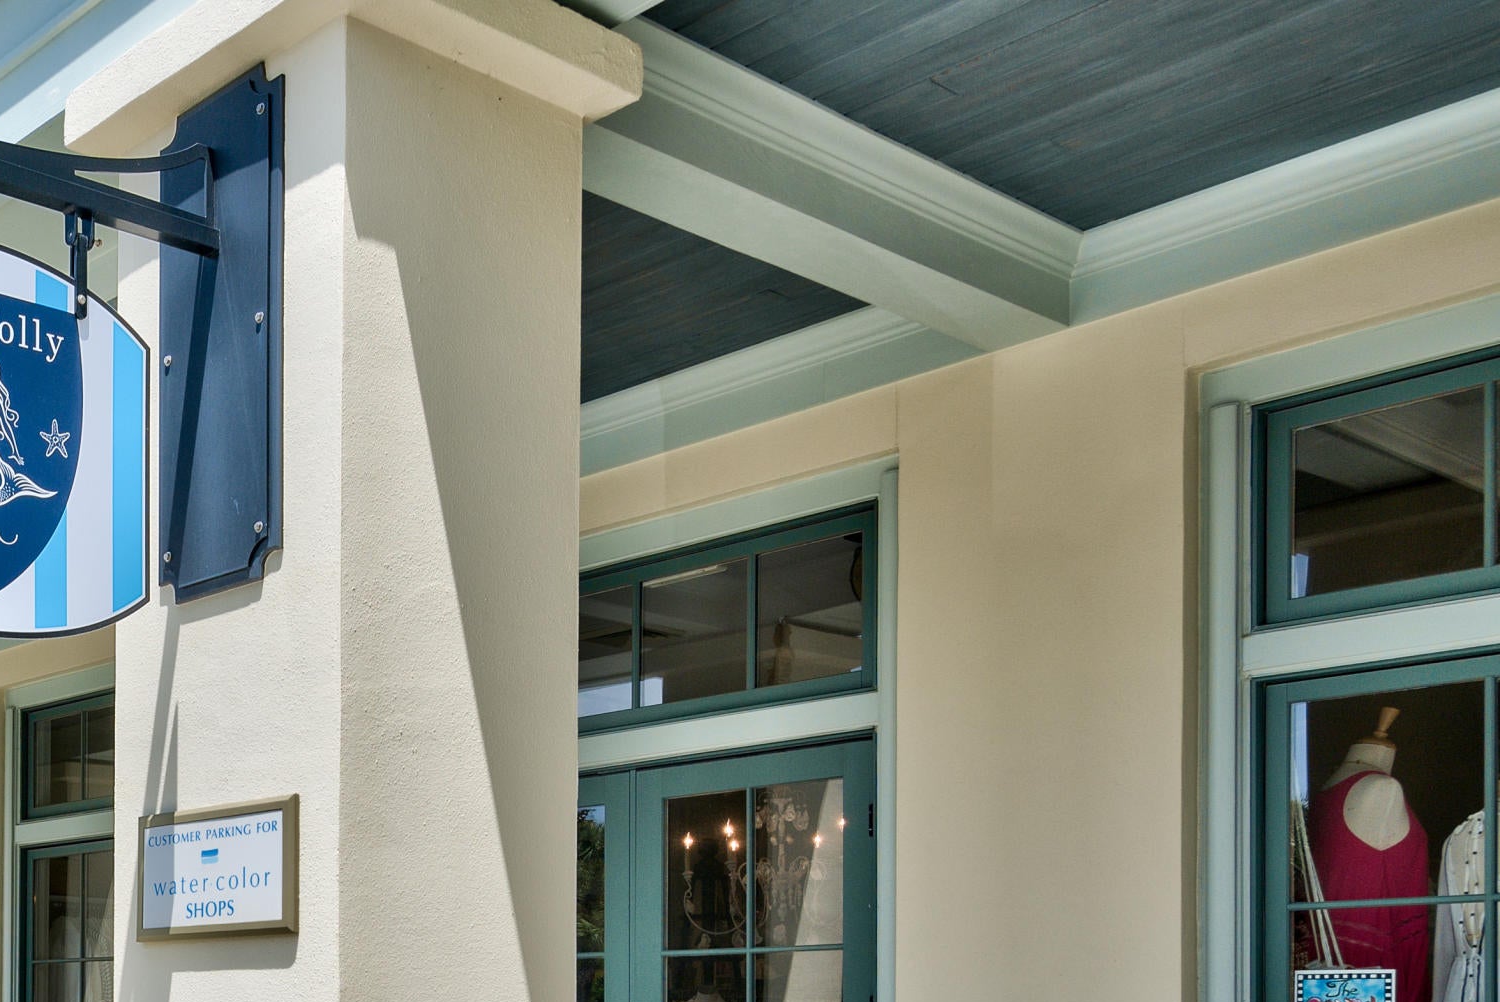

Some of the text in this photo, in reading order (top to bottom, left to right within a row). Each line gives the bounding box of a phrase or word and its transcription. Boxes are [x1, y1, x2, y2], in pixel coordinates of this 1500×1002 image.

[148, 820, 278, 847] CUSTOMER PARKING FOR
[186, 899, 235, 919] SHOPS
[1325, 978, 1358, 998] The
